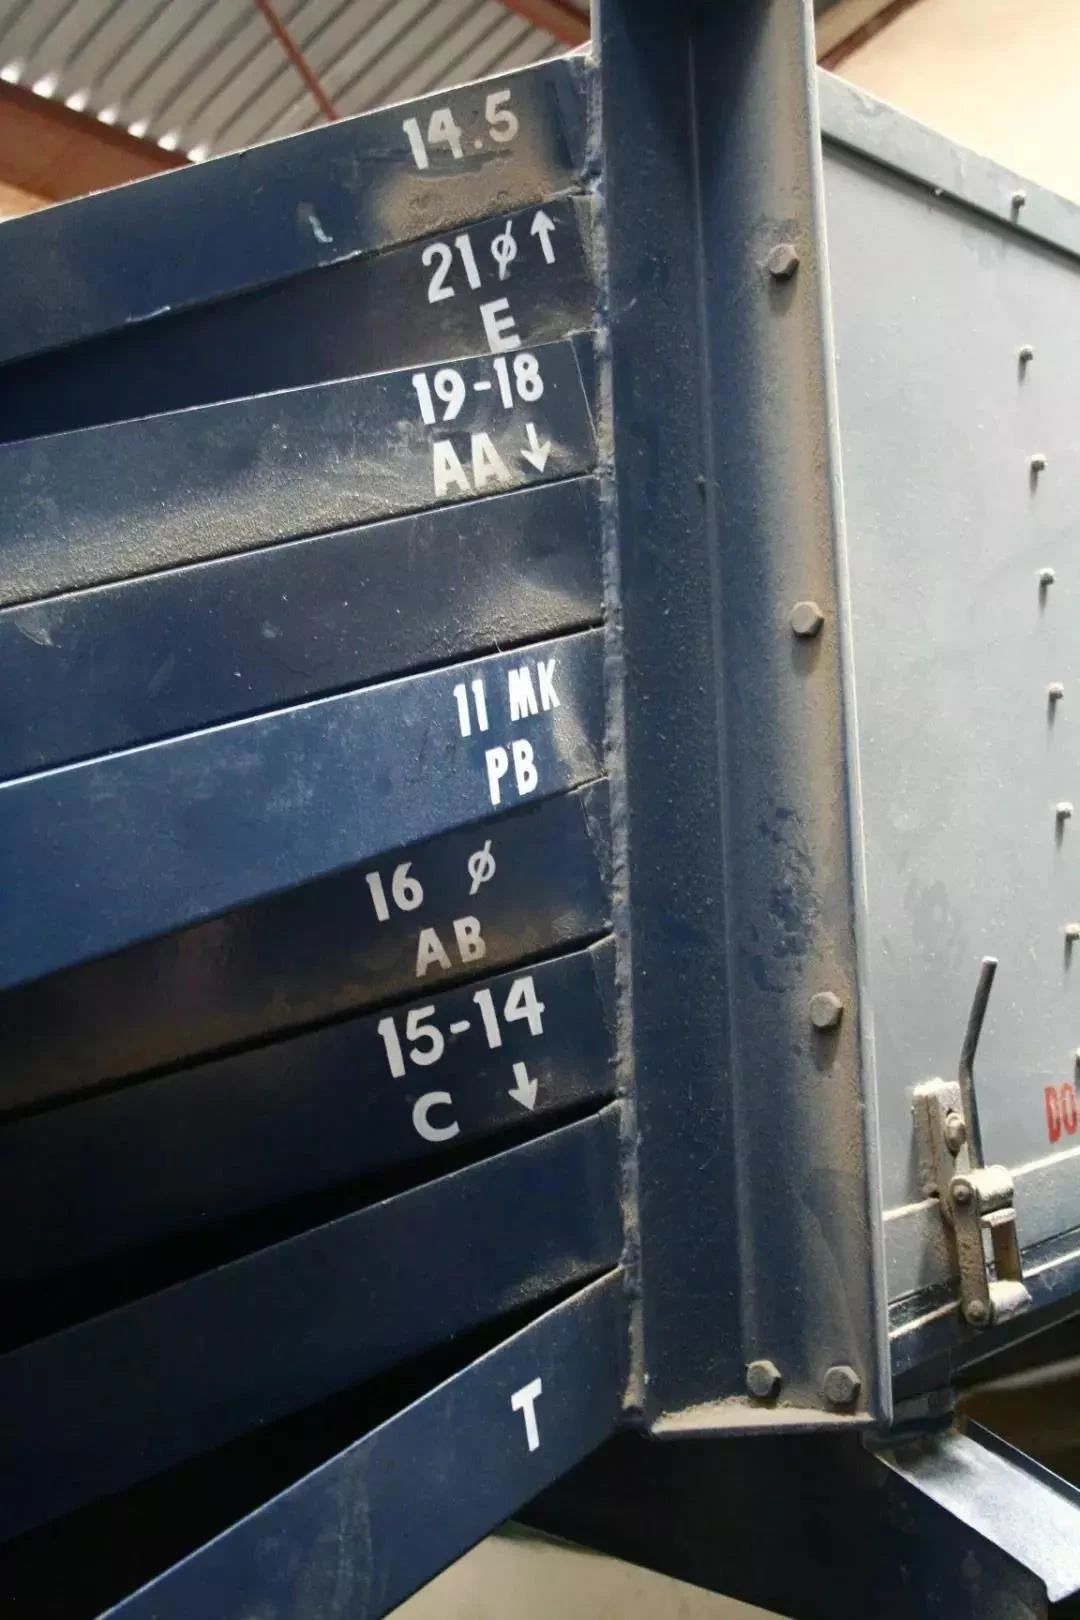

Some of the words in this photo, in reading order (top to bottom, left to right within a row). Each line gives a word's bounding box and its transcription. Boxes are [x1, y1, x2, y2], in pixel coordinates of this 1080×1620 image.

[403, 89, 519, 170] 14.5
[479, 297, 521, 353] E
[412, 353, 544, 425] 19-18
[433, 432, 513, 497] AA
[453, 679, 489, 737] 11
[508, 658, 560, 722] MK
[485, 738, 538, 806] PB
[365, 862, 424, 922] 16
[377, 975, 545, 1078] 15-14
[412, 1091, 460, 1142] C
[511, 1376, 542, 1453] T
